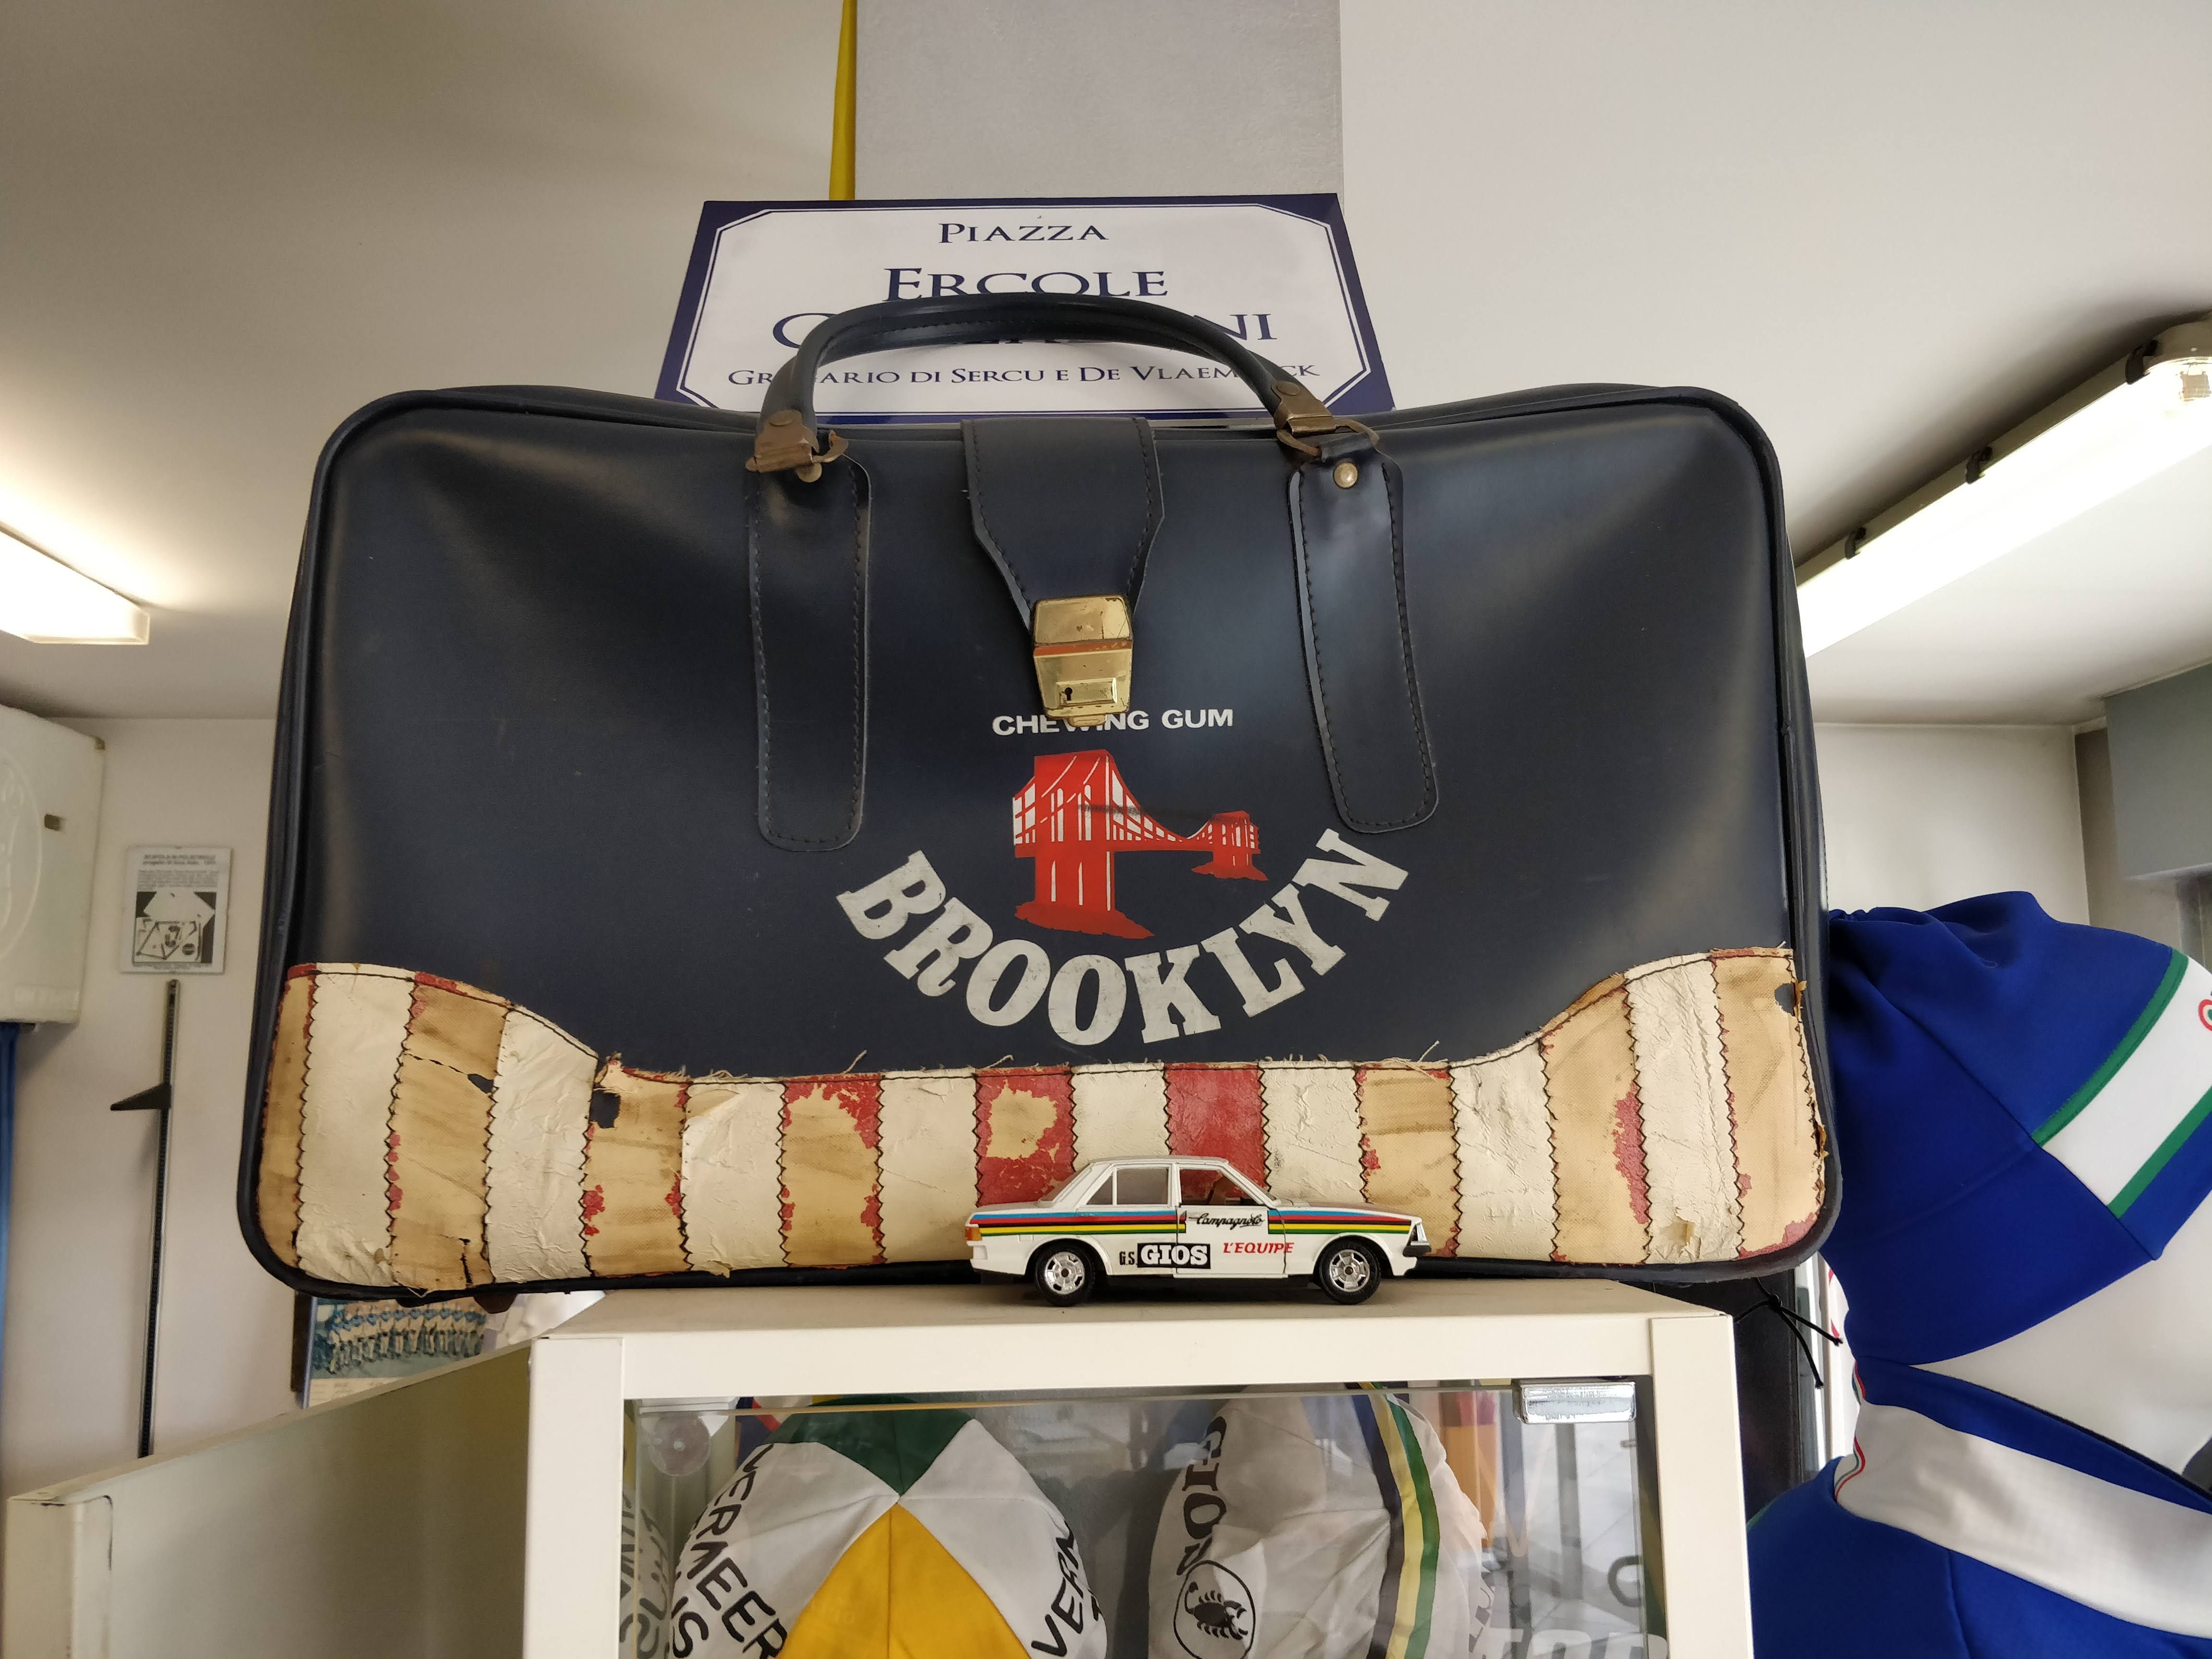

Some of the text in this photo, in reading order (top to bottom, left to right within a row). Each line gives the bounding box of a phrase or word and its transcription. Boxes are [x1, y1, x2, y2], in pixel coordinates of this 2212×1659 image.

[938, 223, 1110, 243] PIAZZA
[883, 267, 1168, 301] ERCOLE
[728, 365, 1320, 385] GRARIO DI SERCU E DE VLAEMCK
[992, 709, 1233, 736] CHENG GUM
[836, 828, 1409, 1046] BROOKLYN
[1189, 1213, 1263, 1230] Campagnolo
[1140, 1245, 1208, 1266] GIOS
[1223, 1242, 1295, 1254] L'EQUIPE
